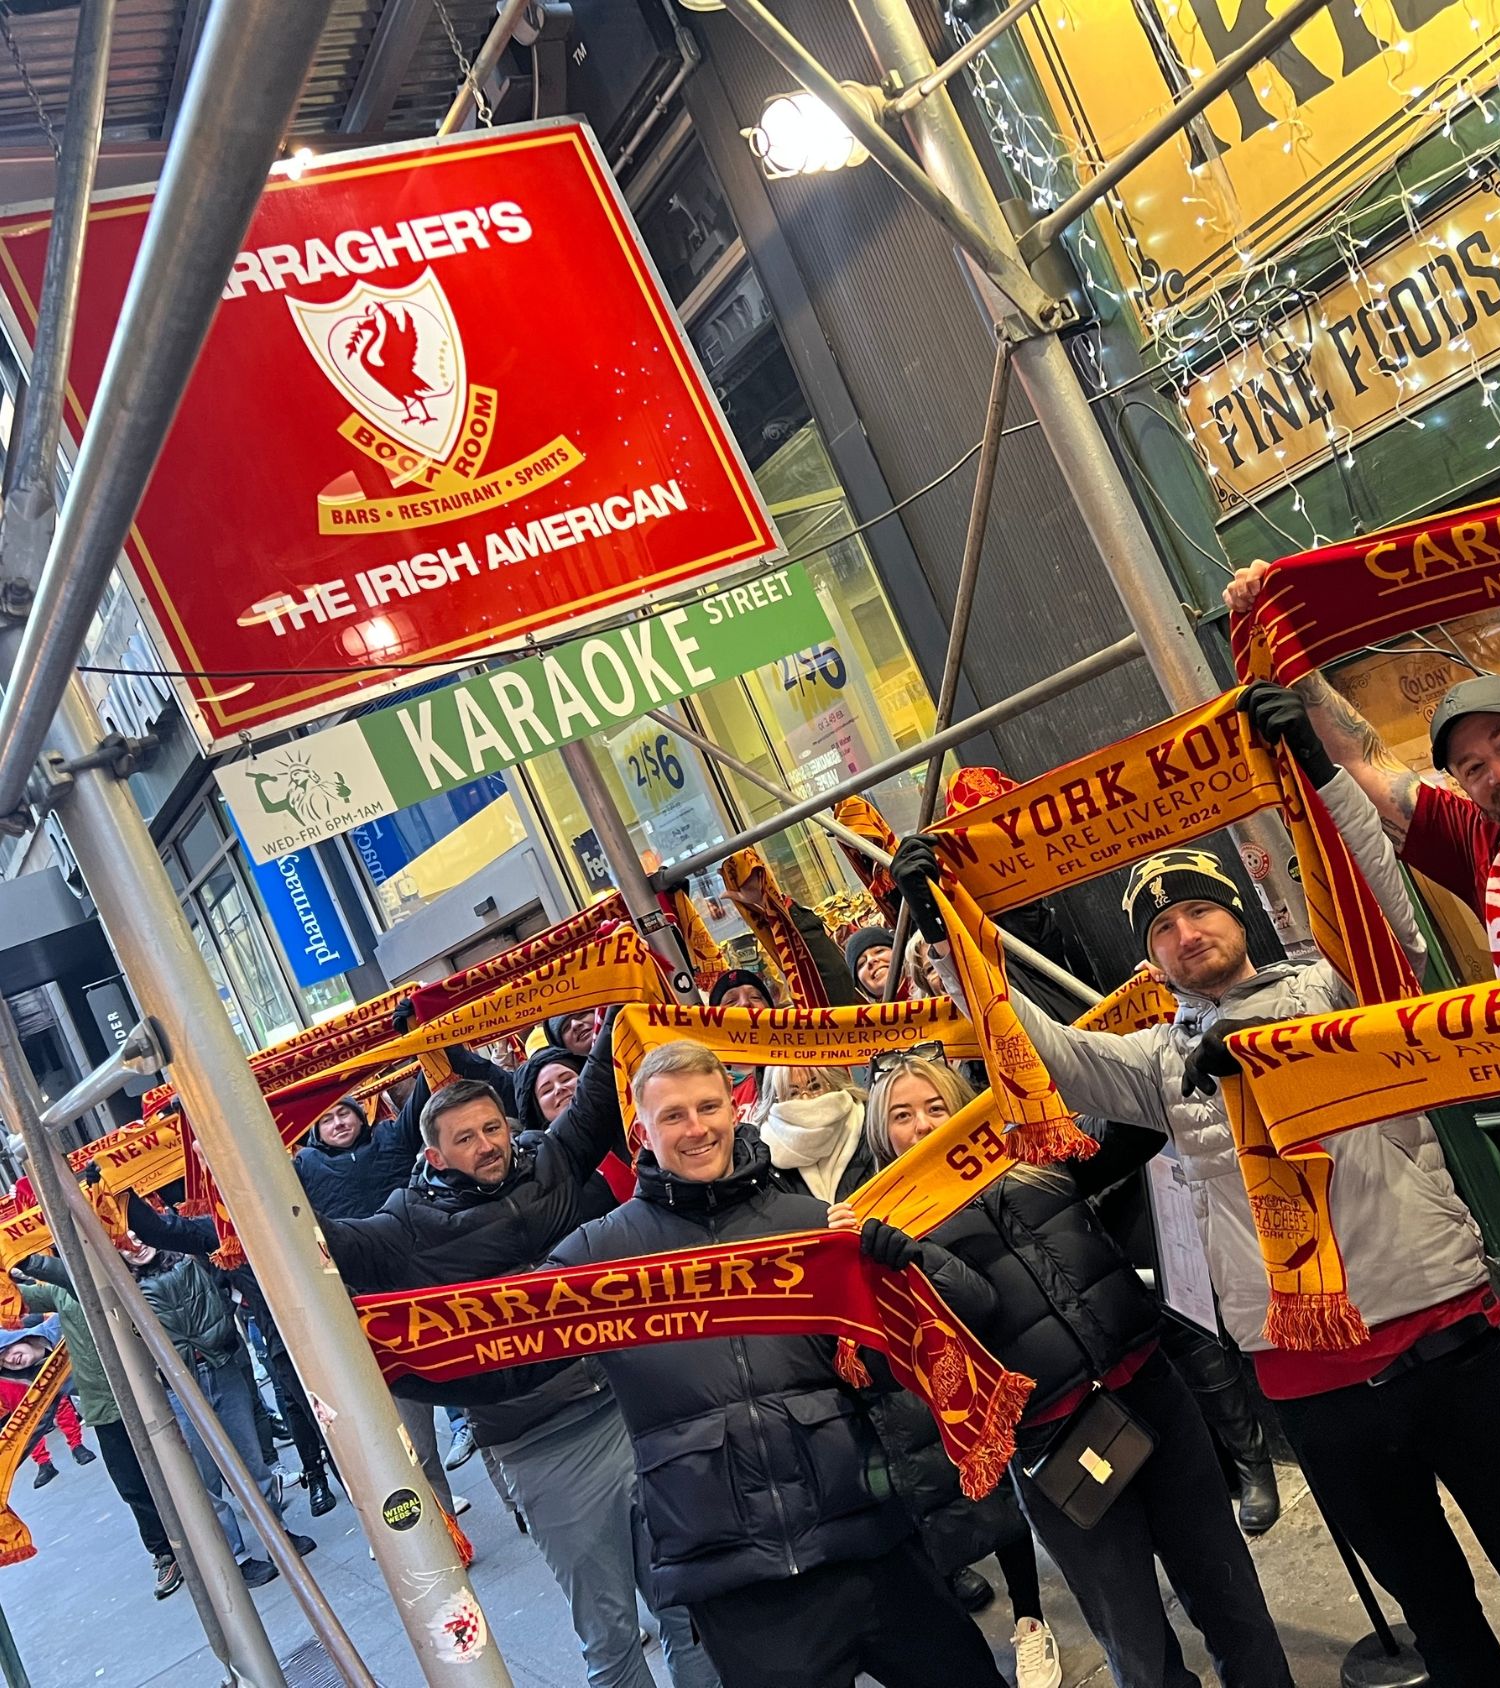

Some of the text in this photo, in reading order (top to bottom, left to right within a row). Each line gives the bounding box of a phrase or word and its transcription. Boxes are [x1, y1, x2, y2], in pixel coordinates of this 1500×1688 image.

[220, 201, 533, 300] RRAGHER'S
[1208, 347, 1335, 469] FINE
[352, 391, 493, 484] BOOT ROOM
[331, 447, 569, 525] BARS RESTAURANT SPORTS
[251, 479, 688, 636] THE IRISH AMERICAN
[702, 570, 794, 625] STREET
[397, 607, 717, 790] KARAOKE
[629, 735, 685, 790] 2/$6
[263, 801, 384, 856] WED-FRI 6PM-1AM
[992, 760, 1138, 850] YORK
[989, 854, 1035, 879] WE
[1045, 826, 1101, 862] ARE
[1056, 804, 1222, 876] EFL CUP FINAL 2024
[277, 853, 340, 966] pharmacy
[423, 976, 580, 1034] ARE LIVERPOOL
[426, 1006, 543, 1046] EFL CUP FINAL 2024
[648, 1003, 727, 1028] NEW
[749, 1007, 840, 1031] YORK
[727, 1026, 929, 1046] WE ARE LIVERPOOL
[770, 1049, 790, 1059] EFL
[794, 1049, 817, 1059] CUP
[820, 1049, 853, 1059] FINAL
[1224, 1014, 1372, 1080] NEW
[1378, 1047, 1441, 1070] WE
[263, 1044, 368, 1094] NEW YORK CITY
[107, 1131, 160, 1168] NEW
[362, 1250, 805, 1349] CARRAGHER'S
[474, 1310, 710, 1366] NEW YORK CITY
[384, 1497, 420, 1518] WIRRAL
